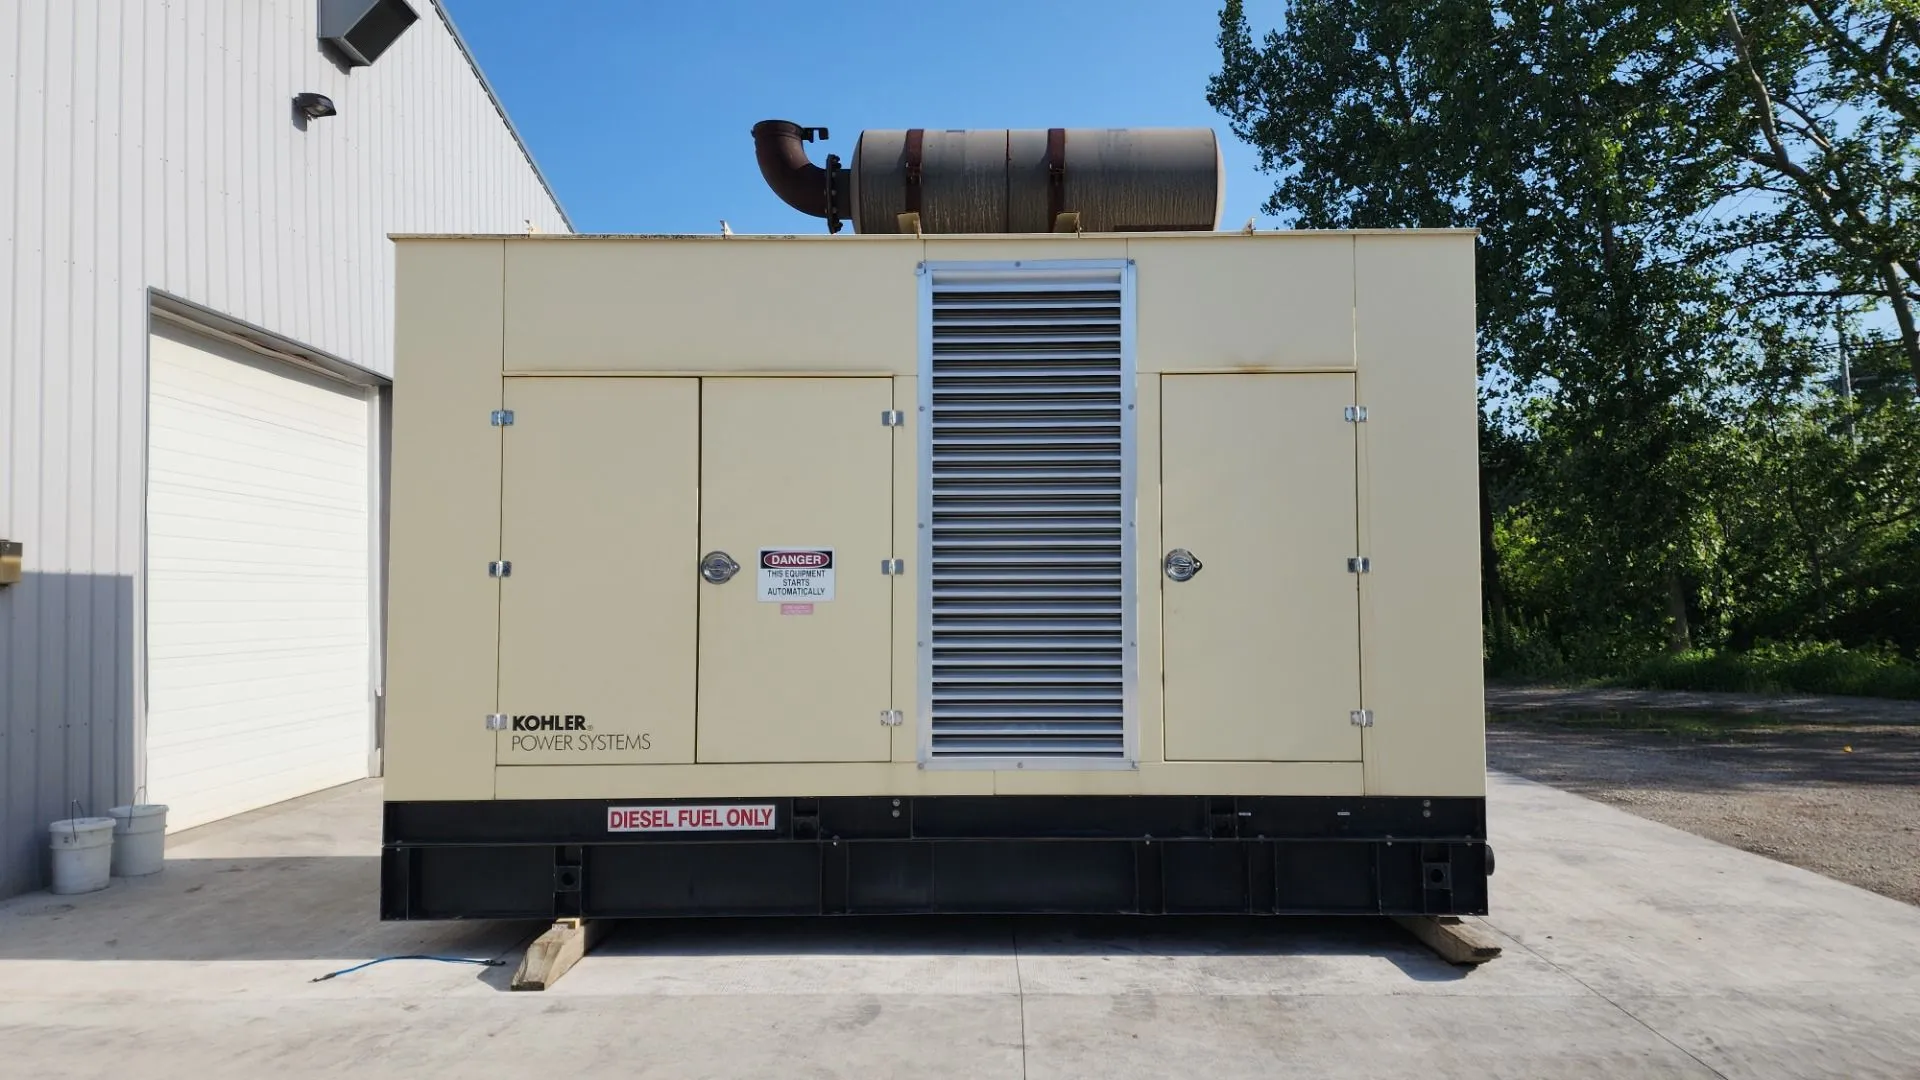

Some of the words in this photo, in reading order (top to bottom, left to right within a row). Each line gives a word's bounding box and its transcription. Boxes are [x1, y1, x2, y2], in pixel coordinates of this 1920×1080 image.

[771, 555, 822, 565] DANGER
[767, 570, 784, 578] THIS
[785, 570, 826, 578] EQUIPMENT
[782, 578, 810, 587] STARTS
[767, 587, 826, 596] AUTOMATICALLY
[512, 715, 587, 731] KOHLER
[511, 734, 574, 751] POWER
[578, 733, 651, 751] SYSTEMS
[610, 810, 674, 829] DIESEL
[678, 809, 723, 828] FUEL
[726, 808, 773, 827] ONLY
